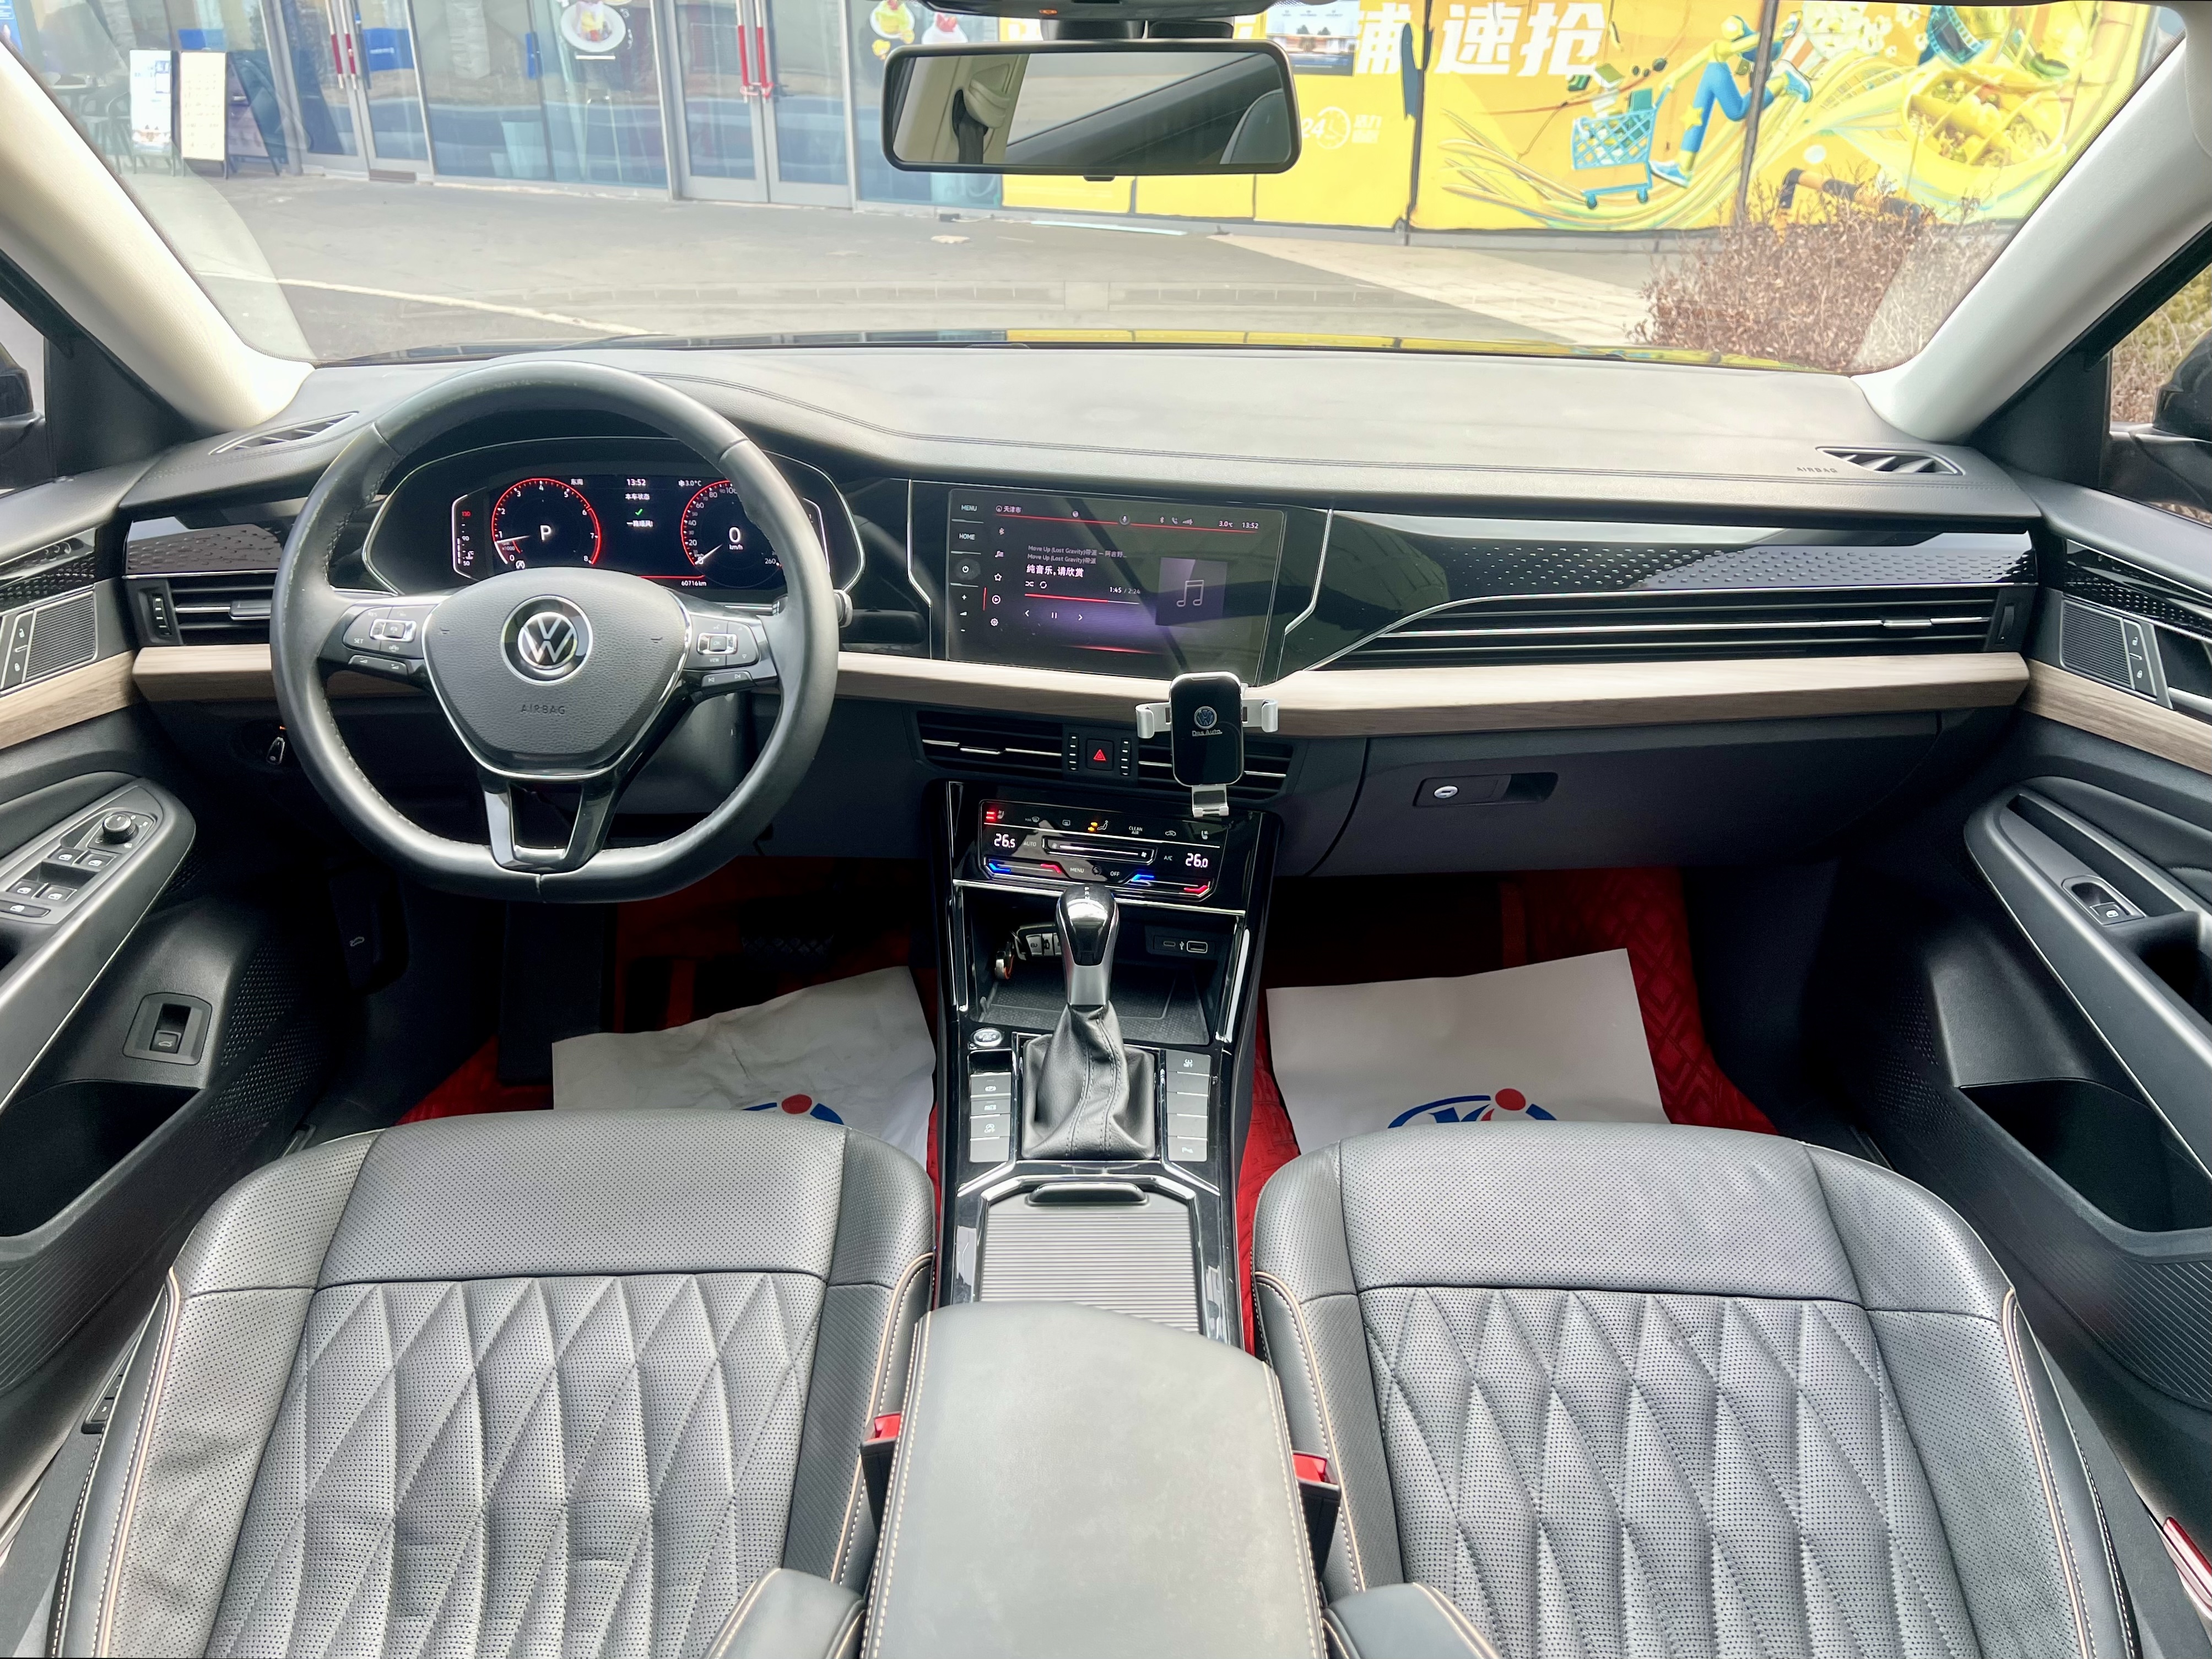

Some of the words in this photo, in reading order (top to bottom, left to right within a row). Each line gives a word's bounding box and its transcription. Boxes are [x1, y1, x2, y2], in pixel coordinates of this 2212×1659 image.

[1241, 521, 1259, 529] 13:52
[539, 525, 551, 542] P
[728, 527, 741, 543] 0
[1109, 586, 1122, 594] 1:45
[521, 704, 569, 716] AIRBAG
